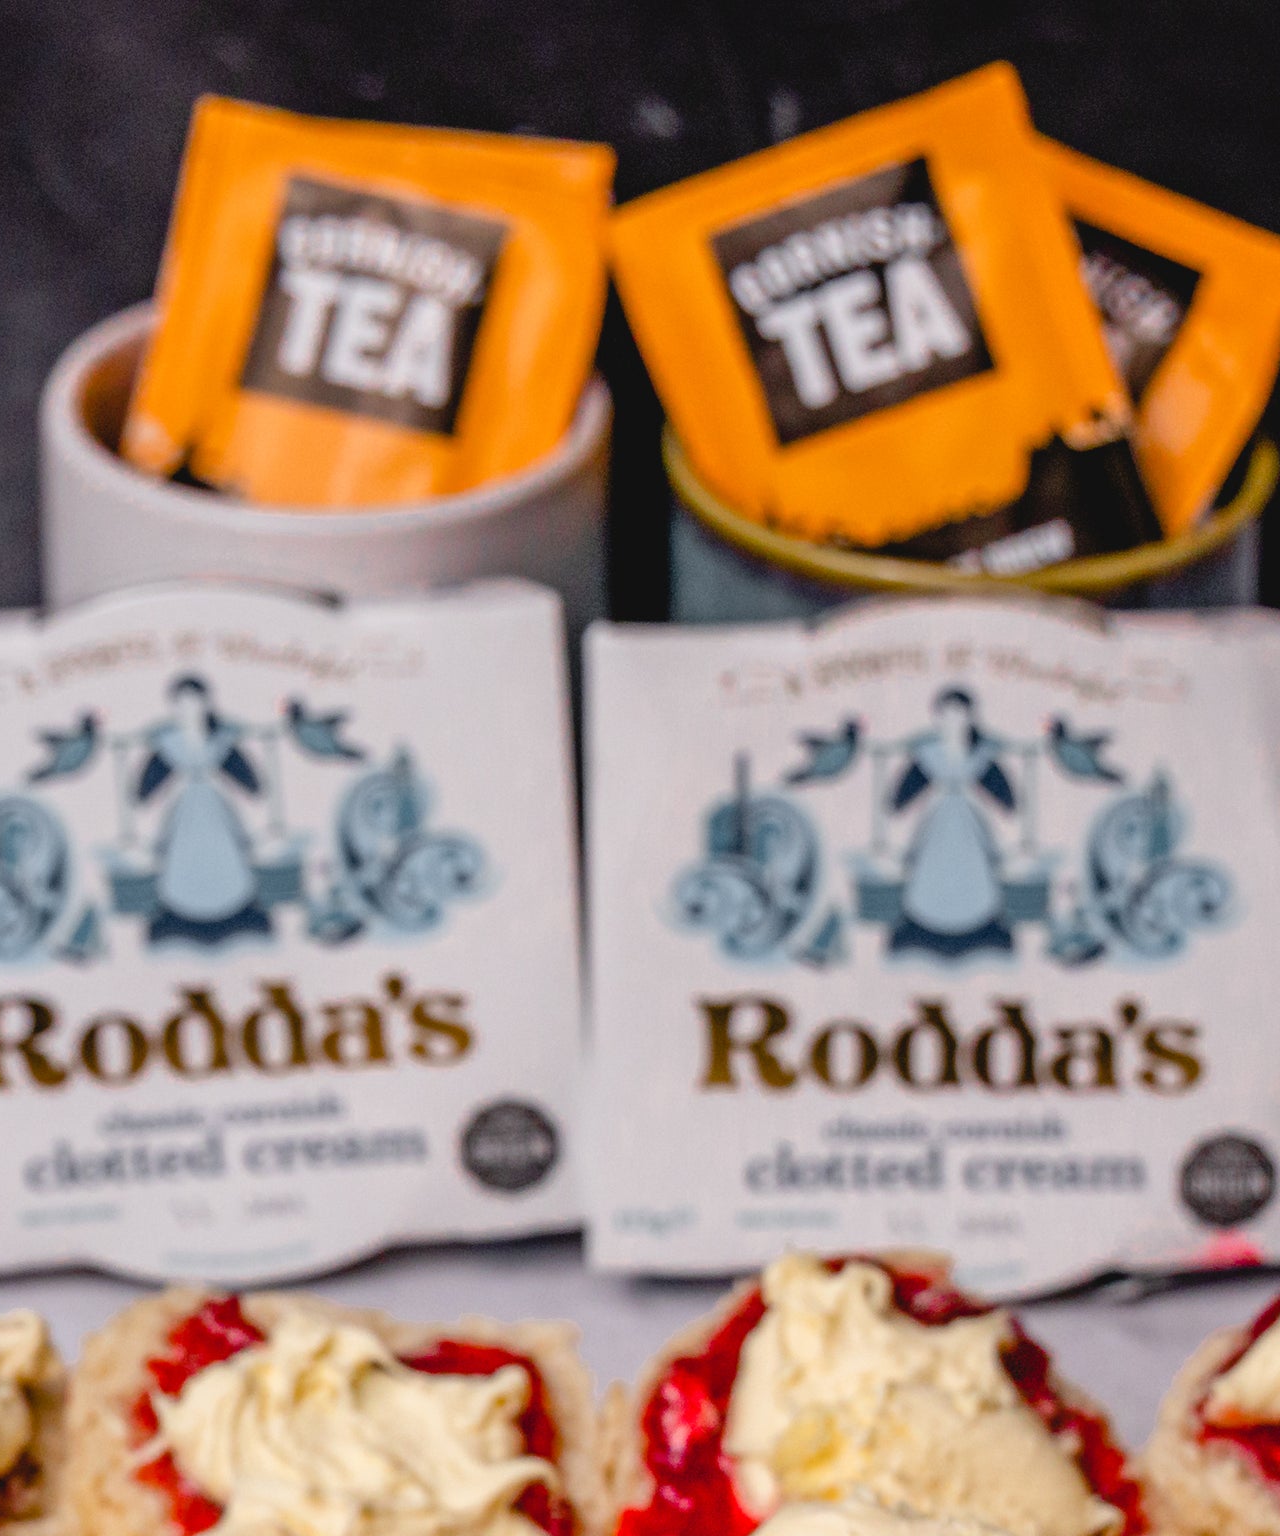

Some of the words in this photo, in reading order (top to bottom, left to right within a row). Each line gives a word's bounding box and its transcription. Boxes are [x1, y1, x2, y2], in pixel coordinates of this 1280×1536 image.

[273, 272, 456, 408] TEA
[756, 254, 970, 409] TEA
[692, 995, 1204, 1094] Rodda's
[26, 1136, 225, 1194] clotted
[242, 1127, 426, 1174] cream
[745, 1141, 945, 1193] clotted
[963, 1154, 1146, 1194] cream
